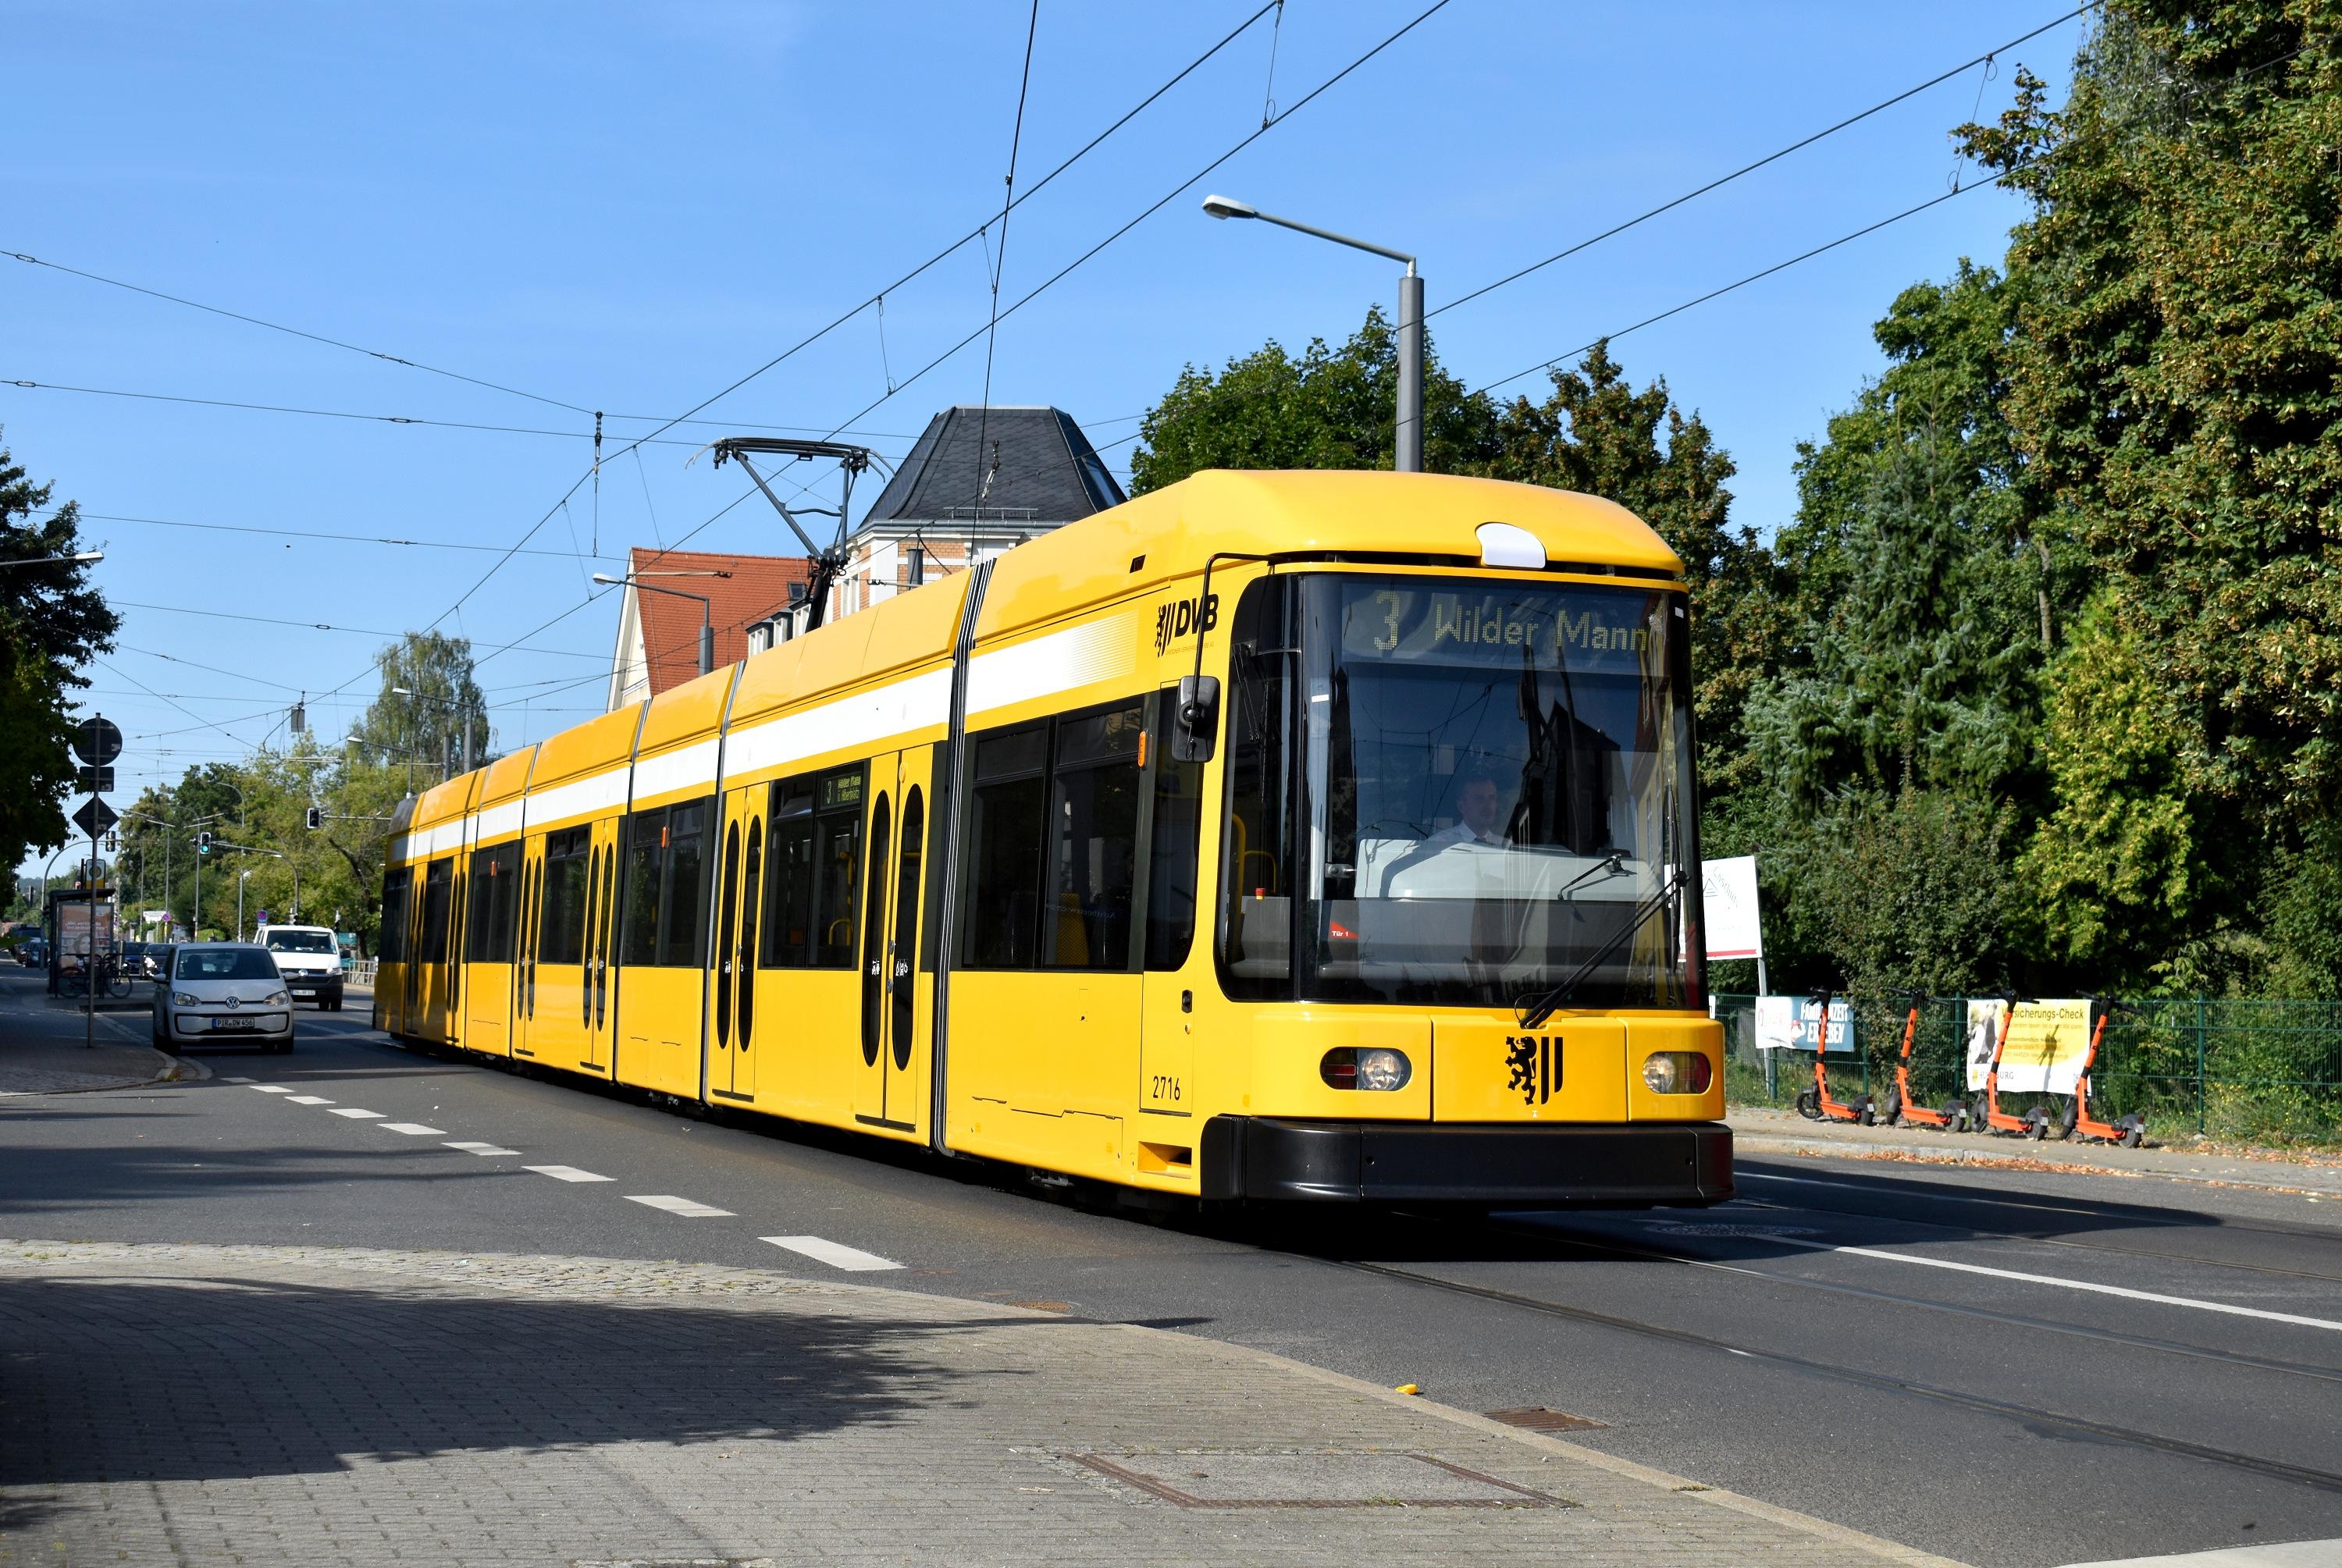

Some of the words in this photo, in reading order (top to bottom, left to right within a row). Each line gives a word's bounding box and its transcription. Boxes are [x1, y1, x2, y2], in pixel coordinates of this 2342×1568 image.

[1173, 593, 1219, 638] DVB
[1374, 591, 1400, 651] 3
[1434, 603, 1539, 645] Wilder
[1556, 610, 1649, 652] Mann
[2002, 1008, 2085, 1021] Vrsicherungs-Check
[1152, 1075, 1180, 1100] 2716
